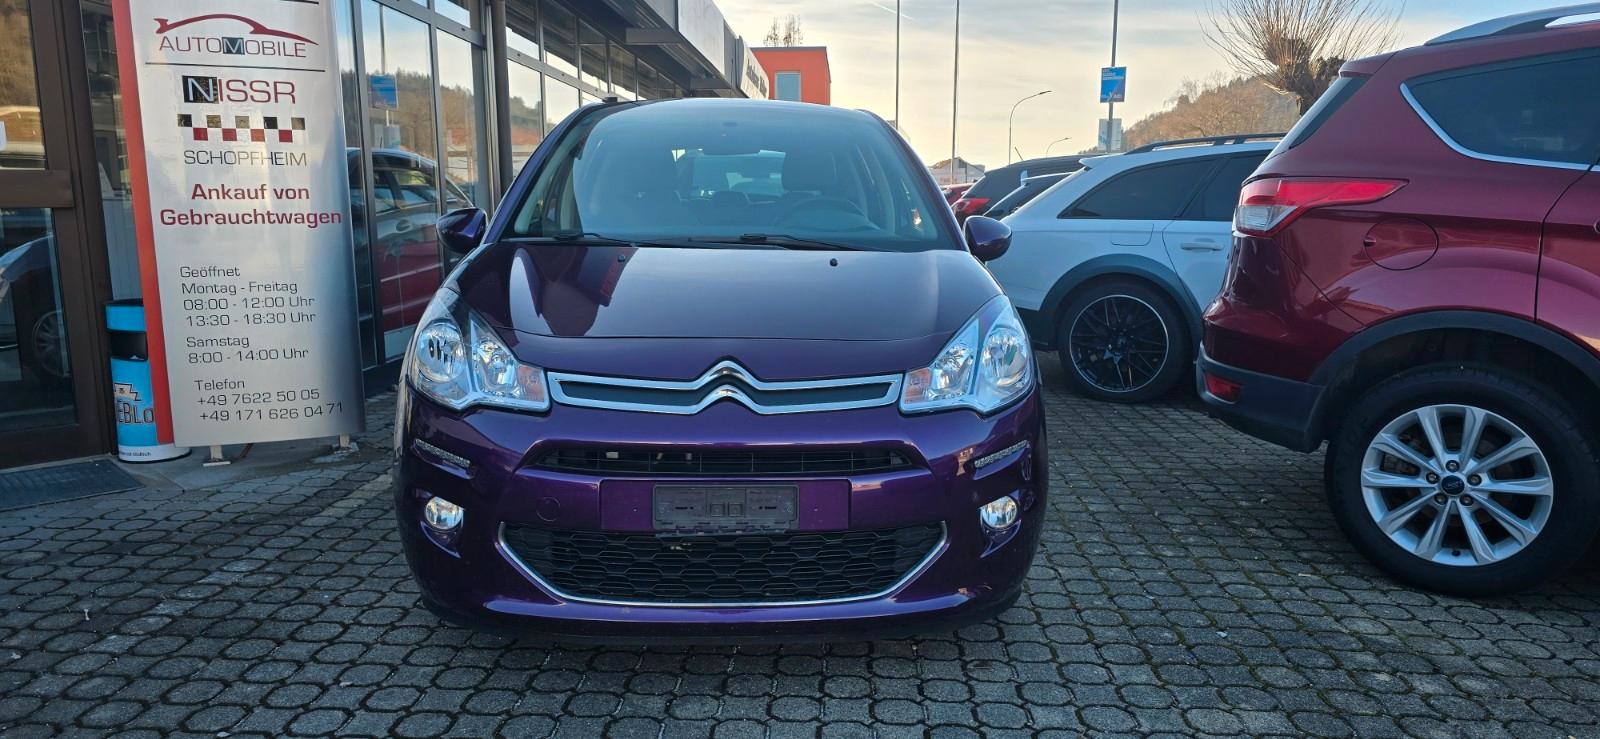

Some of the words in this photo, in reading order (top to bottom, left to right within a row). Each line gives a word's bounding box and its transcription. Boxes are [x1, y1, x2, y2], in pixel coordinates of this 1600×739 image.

[187, 76, 296, 104] NISSR
[184, 150, 307, 166] SCHOPFHEIM
[192, 184, 267, 200] Ankauf
[273, 187, 310, 200] von
[160, 209, 342, 228] Gebrauchtwagen
[180, 266, 240, 278] Geöffnet
[182, 283, 237, 295] Montag
[249, 282, 298, 294] Freitag
[184, 299, 228, 311] 08:00
[242, 297, 284, 309] 12:00
[289, 296, 315, 307] Uhr
[186, 315, 230, 326] 13:30
[243, 313, 286, 324] 18:30
[291, 312, 316, 323] Uhr
[187, 336, 249, 347] Samstag
[189, 352, 222, 364] 8:00
[236, 350, 278, 361] 14:00
[283, 349, 309, 359] Uhr
[194, 380, 245, 391] Telefon
[197, 395, 227, 406] +49
[233, 393, 272, 404] 7622
[277, 391, 296, 402] 50
[301, 389, 320, 400] 05
[200, 411, 229, 422] +49
[236, 410, 263, 421] 171
[269, 408, 299, 419] 626
[304, 406, 323, 417] 04
[328, 402, 343, 415] 71
